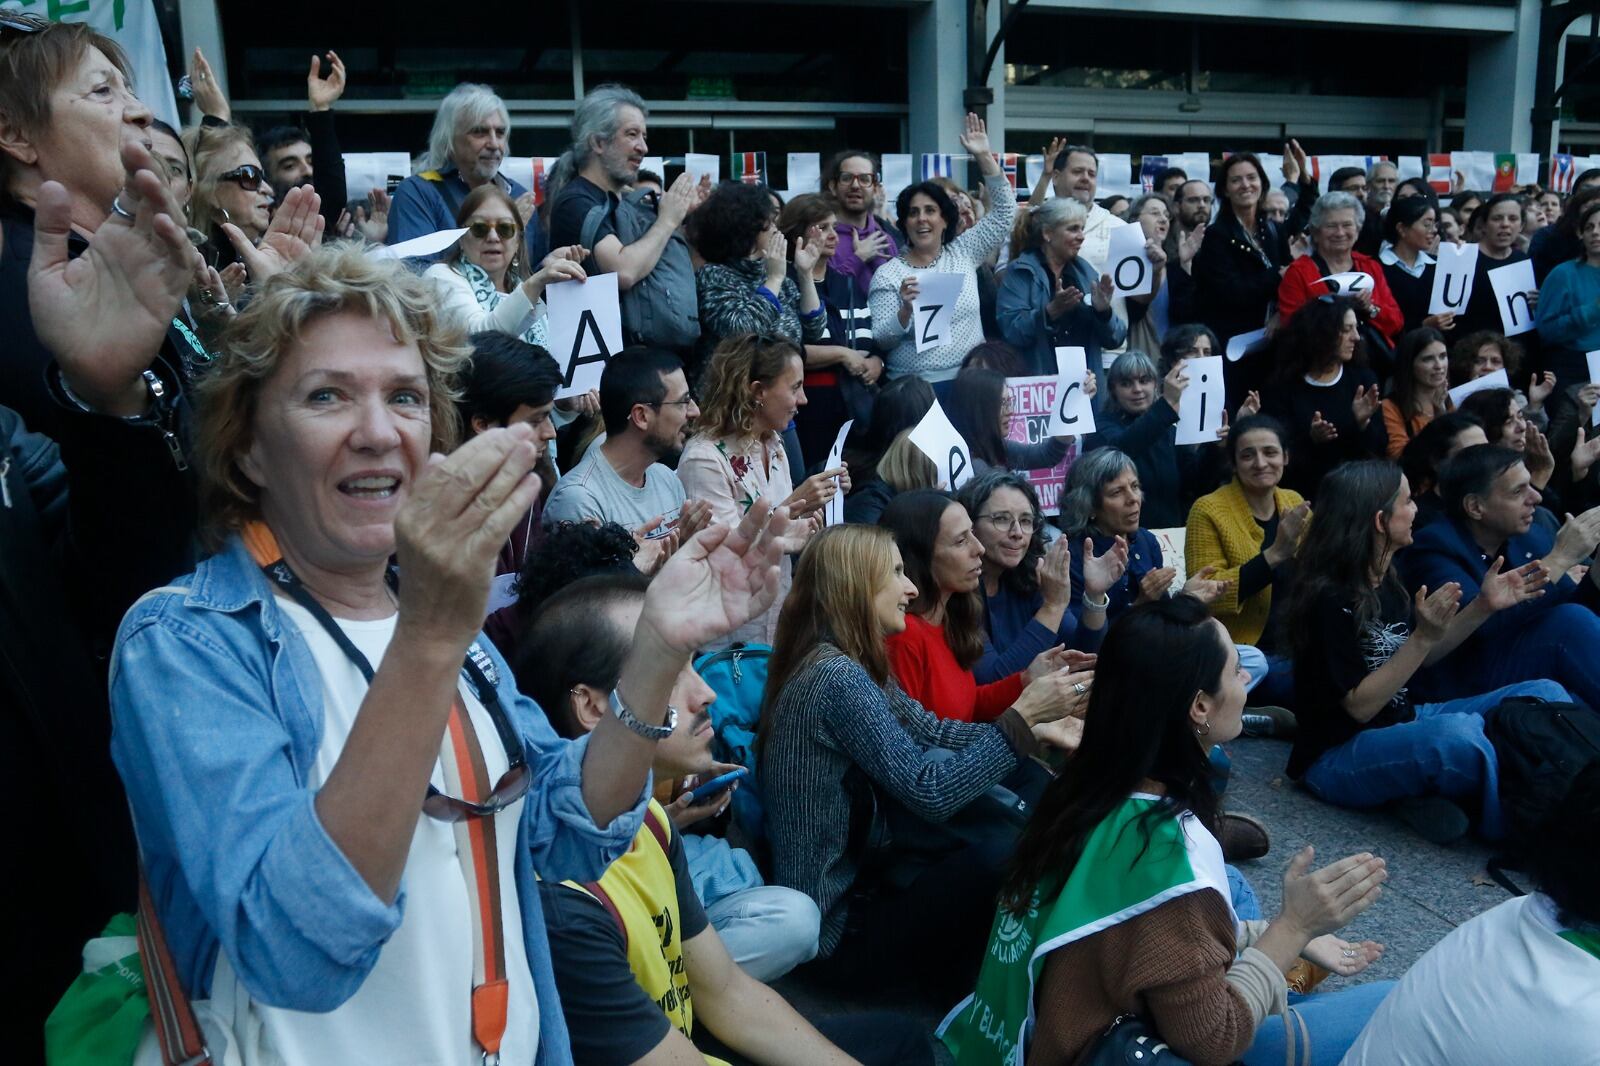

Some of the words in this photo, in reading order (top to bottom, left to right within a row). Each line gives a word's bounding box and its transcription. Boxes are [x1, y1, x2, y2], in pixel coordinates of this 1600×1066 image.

[1443, 274, 1468, 308] u
[1506, 291, 1535, 326] n
[563, 309, 612, 388] A
[1200, 374, 1208, 432] i
